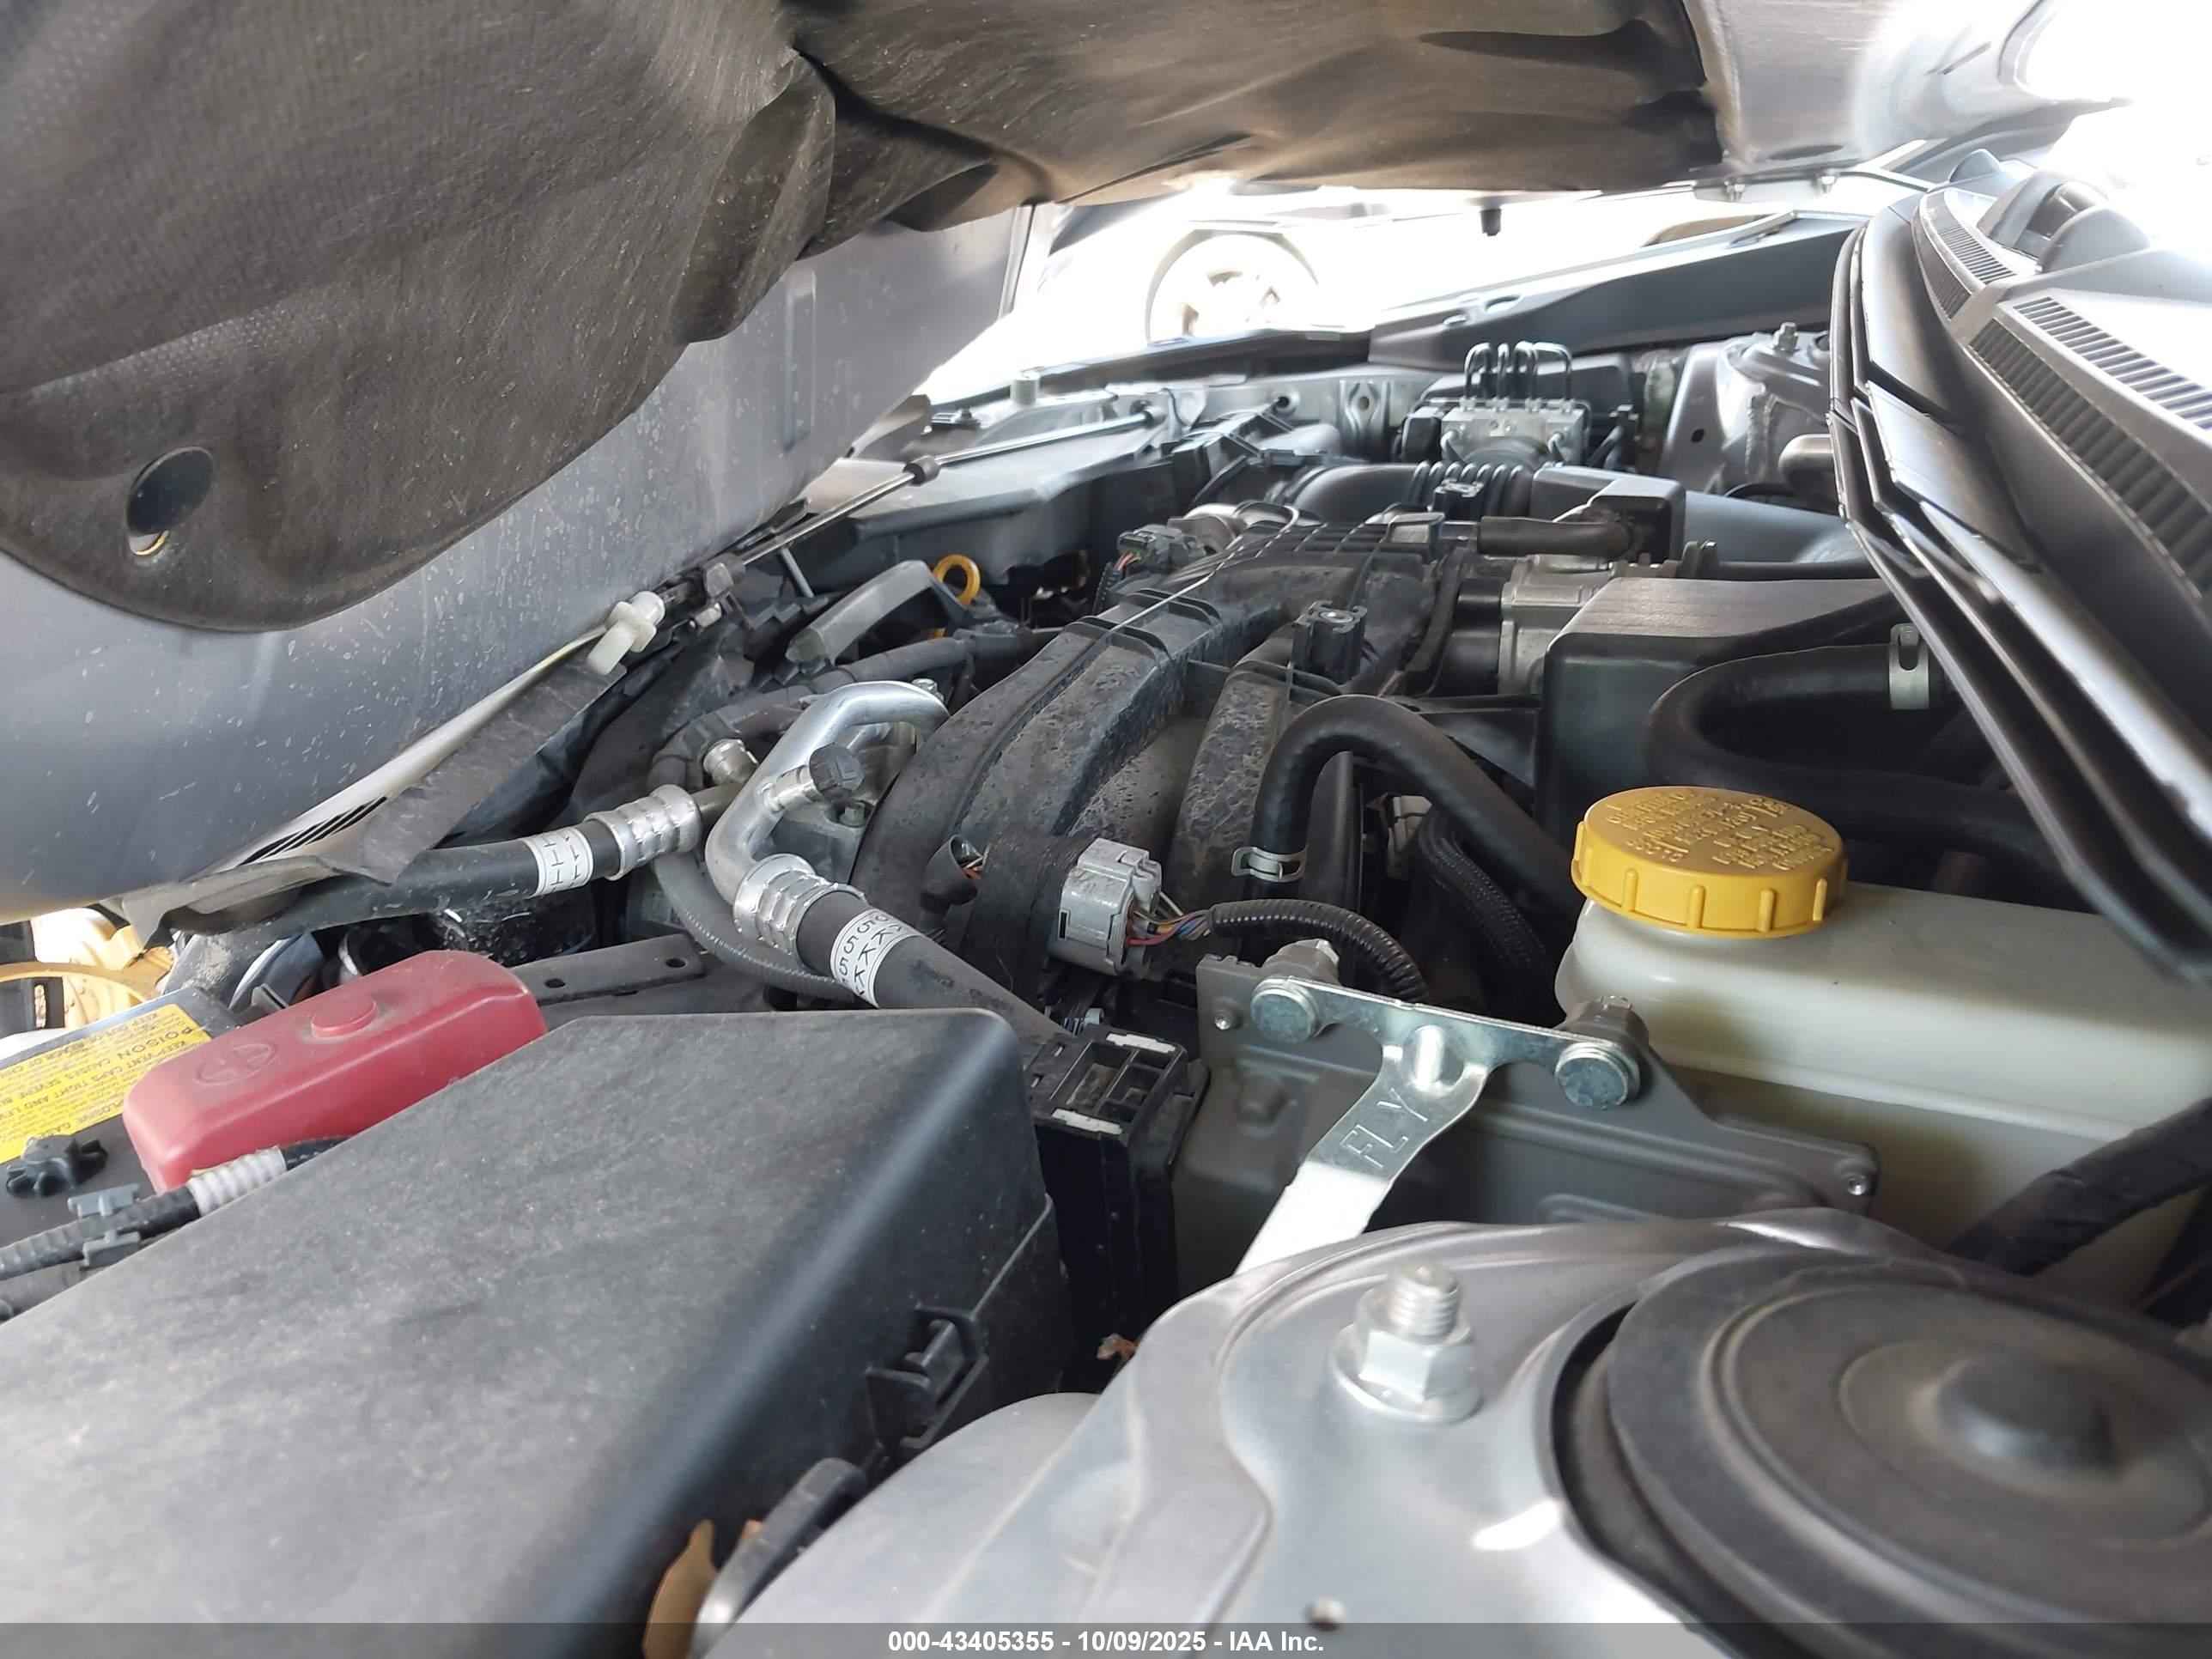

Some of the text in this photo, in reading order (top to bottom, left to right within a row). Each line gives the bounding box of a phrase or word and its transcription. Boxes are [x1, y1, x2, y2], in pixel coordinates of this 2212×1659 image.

[118, 1025, 193, 1060] POISON
[24, 1095, 49, 1109] AND
[1340, 1087, 1428, 1170] FLY
